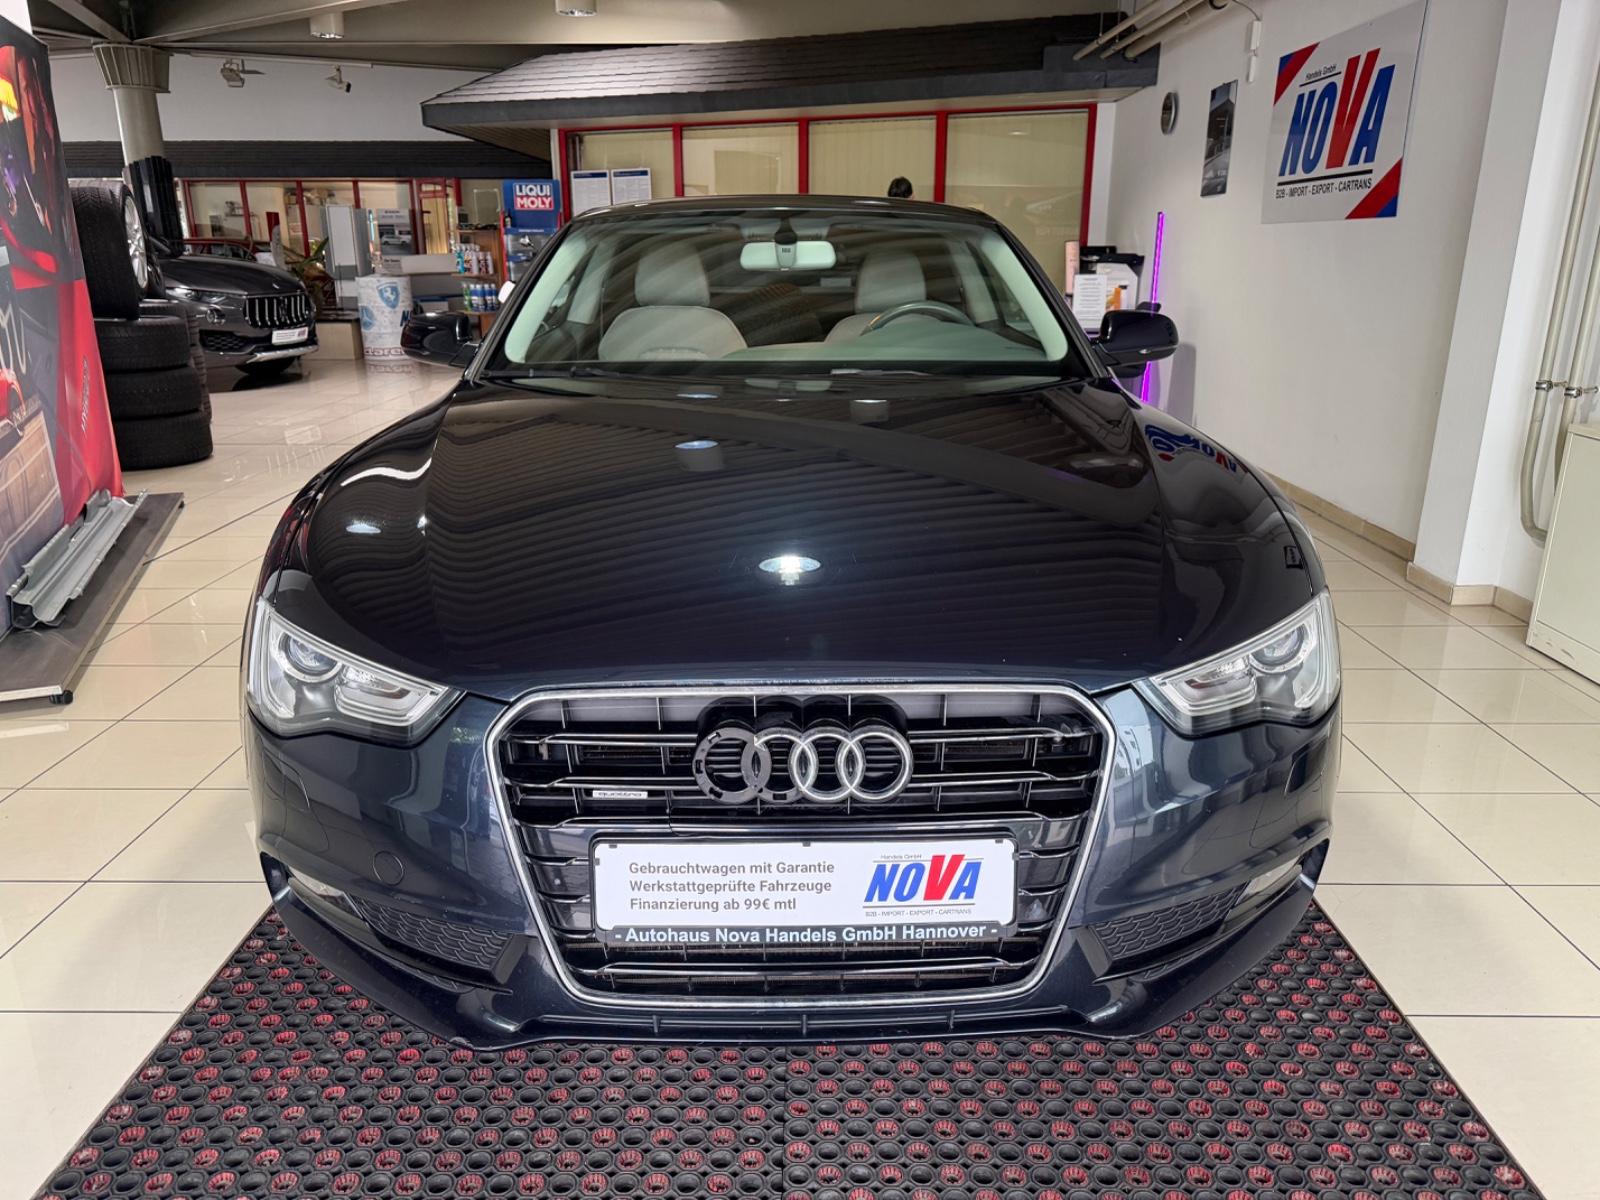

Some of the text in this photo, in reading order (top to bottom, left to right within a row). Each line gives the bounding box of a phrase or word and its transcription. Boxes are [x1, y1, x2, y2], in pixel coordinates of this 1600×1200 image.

[1278, 48, 1395, 177] NOVA
[516, 185, 551, 196] LIQUI
[1289, 186, 1308, 198] IMPORT
[1311, 182, 1335, 195] EXPORT
[1338, 178, 1373, 192] CARTRANS
[516, 197, 552, 208] MOLY
[629, 860, 835, 876] Gebrauchtwagen mit Garantie
[629, 878, 832, 894] Werkstattgeprüfte Fahrzeuge
[864, 854, 982, 902] NOVA
[630, 897, 797, 912] Finanzierung ab 99€ mtl
[625, 928, 710, 942] Autohaus
[715, 928, 760, 942] Nova
[765, 927, 837, 942] Handels
[842, 926, 896, 941] GmbH
[902, 925, 986, 940] Hannover
